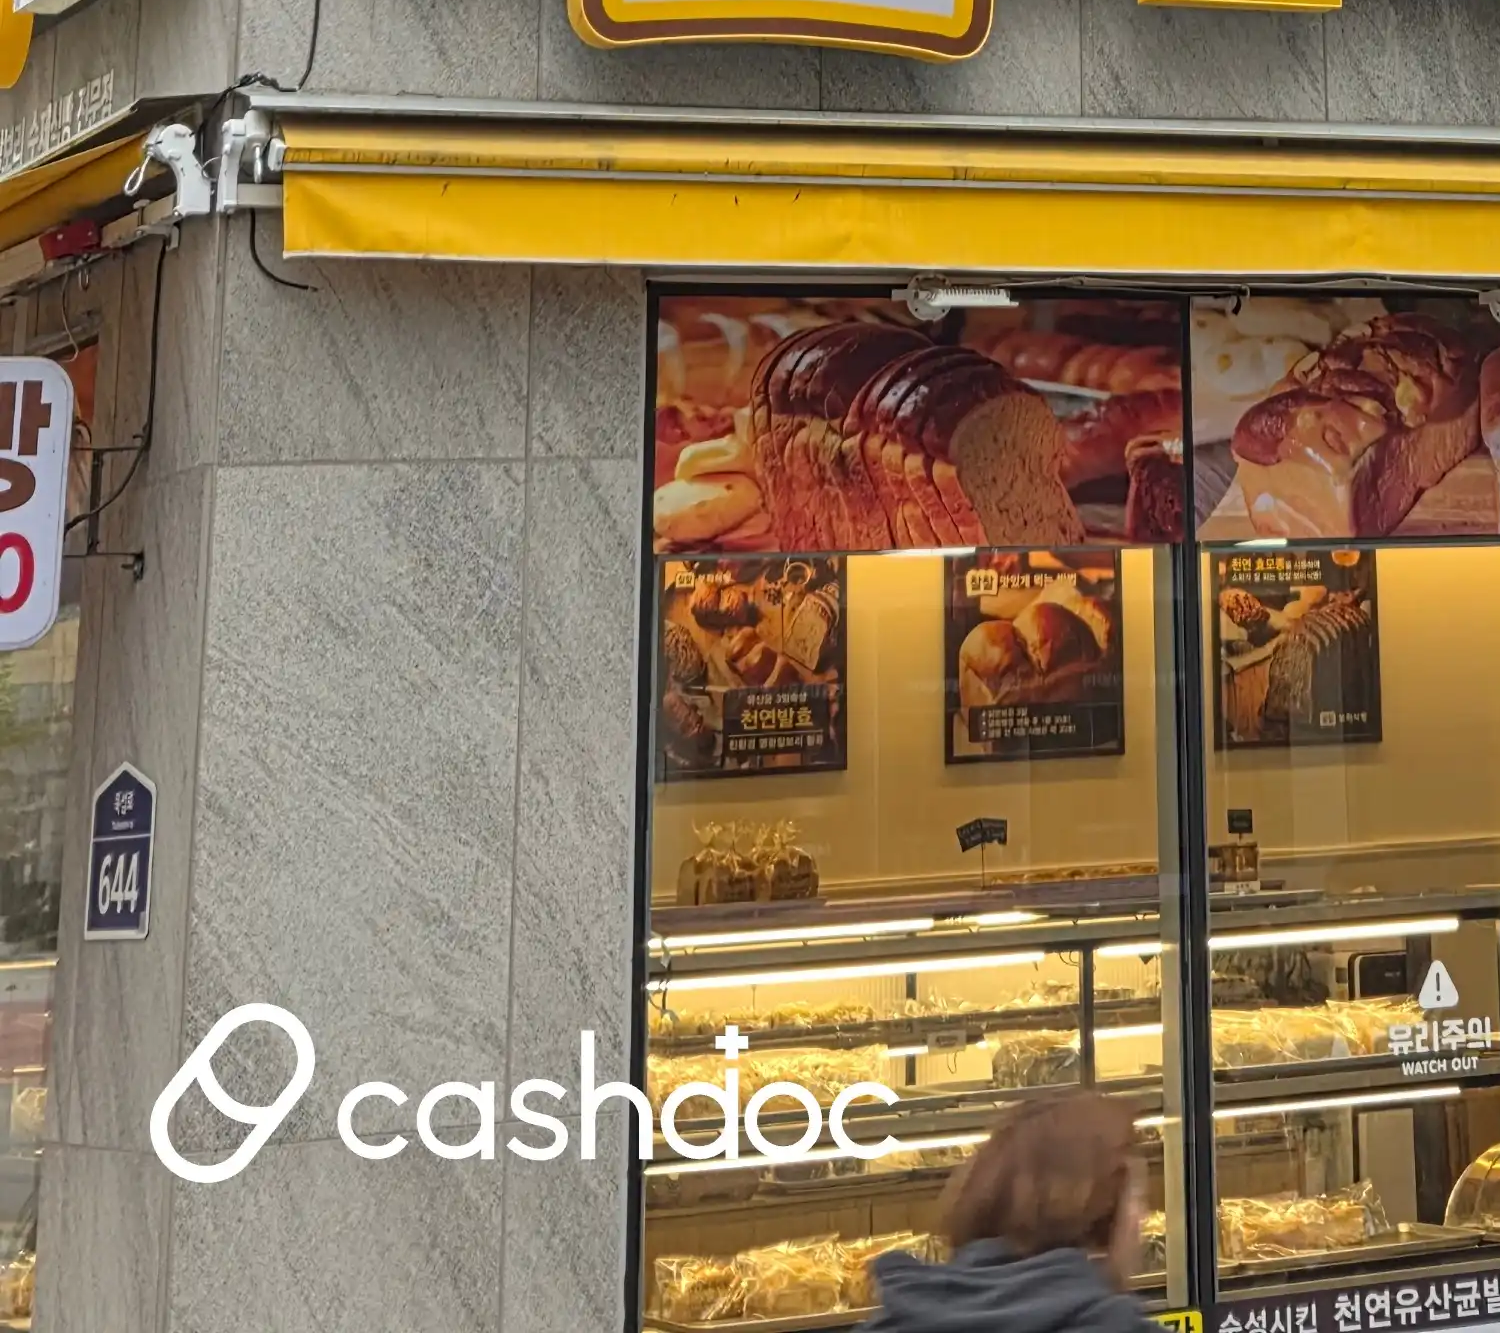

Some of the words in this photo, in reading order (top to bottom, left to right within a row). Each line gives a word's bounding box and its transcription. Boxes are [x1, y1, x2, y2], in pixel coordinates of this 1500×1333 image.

[0, 116, 25, 175] 보리
[740, 707, 815, 731] 천연발효
[97, 850, 141, 916] 644
[1387, 1016, 1492, 1056] 유리주의
[1401, 1058, 1448, 1077] WATCH
[1451, 1056, 1479, 1071] OUT
